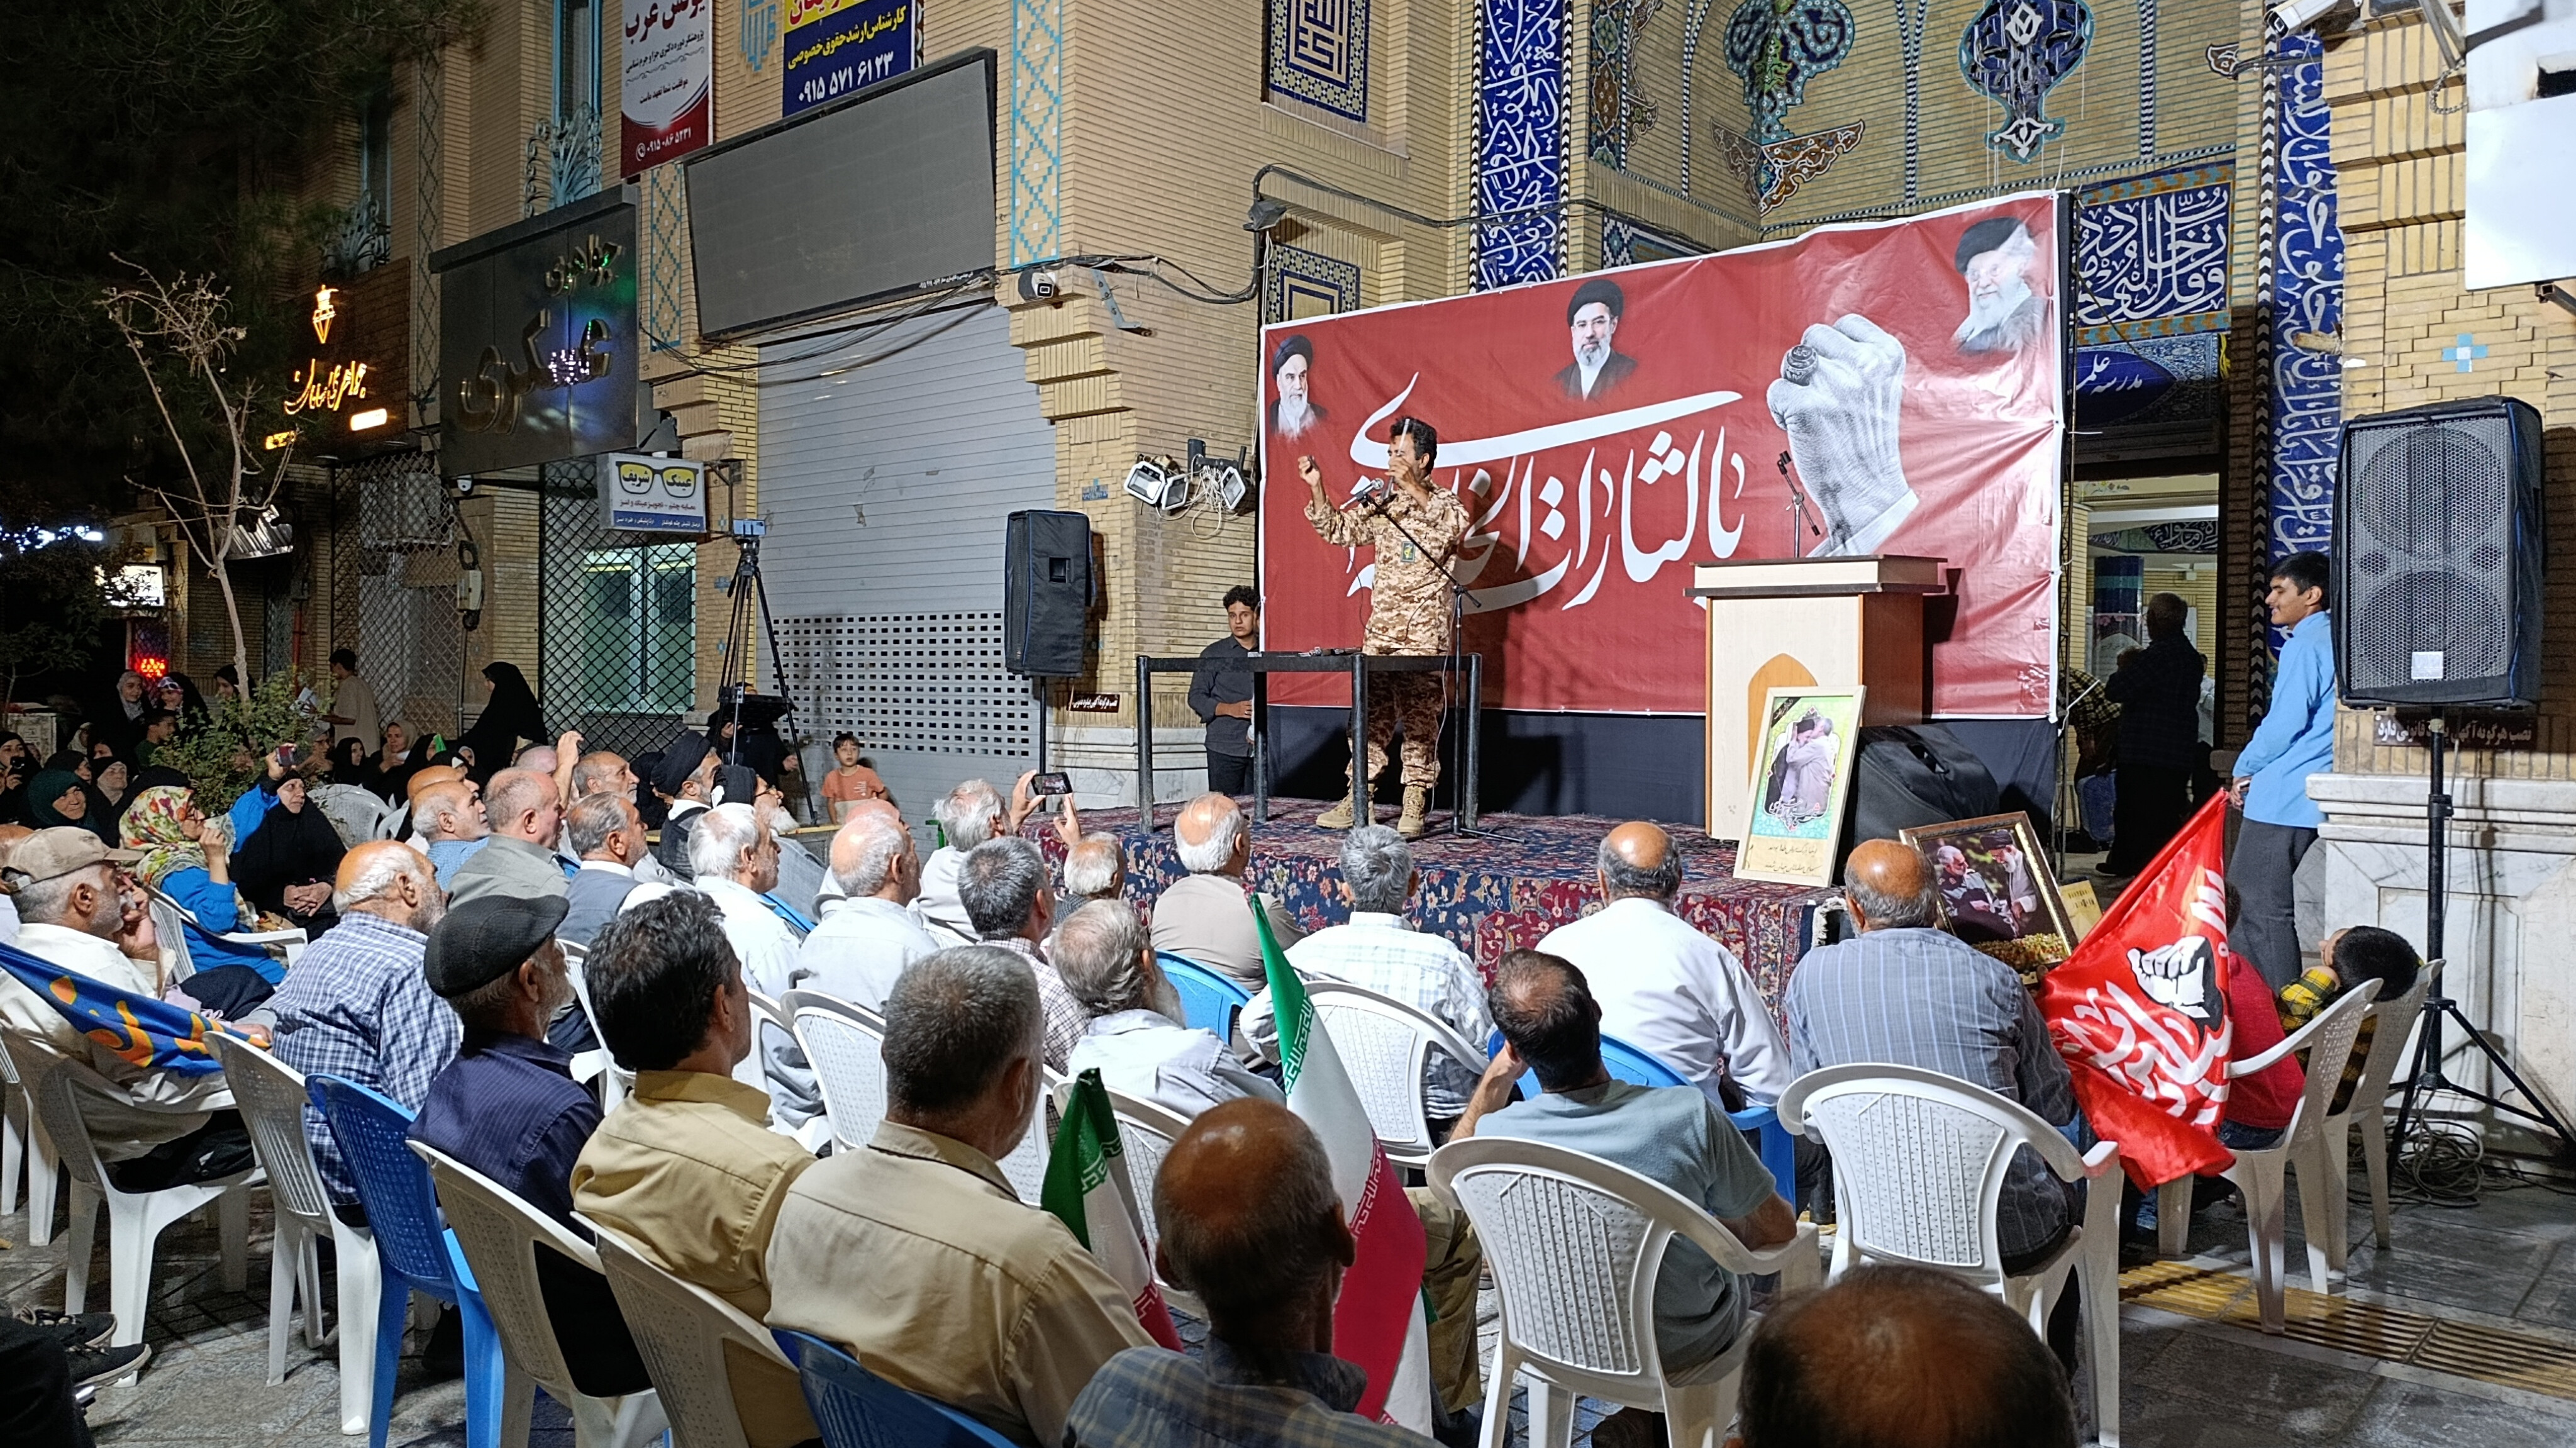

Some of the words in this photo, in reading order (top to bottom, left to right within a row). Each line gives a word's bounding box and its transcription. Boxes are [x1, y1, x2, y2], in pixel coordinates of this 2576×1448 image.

[625, 3, 658, 45] عرب
[846, 21, 867, 43] ارشد
[866, 5, 906, 39] کارشناس
[788, 39, 823, 69] خصوصی
[823, 32, 847, 55] حقوق
[799, 76, 825, 103] ۰۹۱۵
[830, 66, 852, 95] ۵۷۱
[459, 308, 613, 435] عسکری
[2090, 374, 2143, 396] مدرسه
[622, 469, 650, 487] شریف
[666, 474, 692, 491] عینک
[2377, 720, 2396, 742] دارد
[2396, 719, 2426, 742] قانونی
[2450, 720, 2477, 744] آگهی
[2509, 724, 2532, 745] نصب
